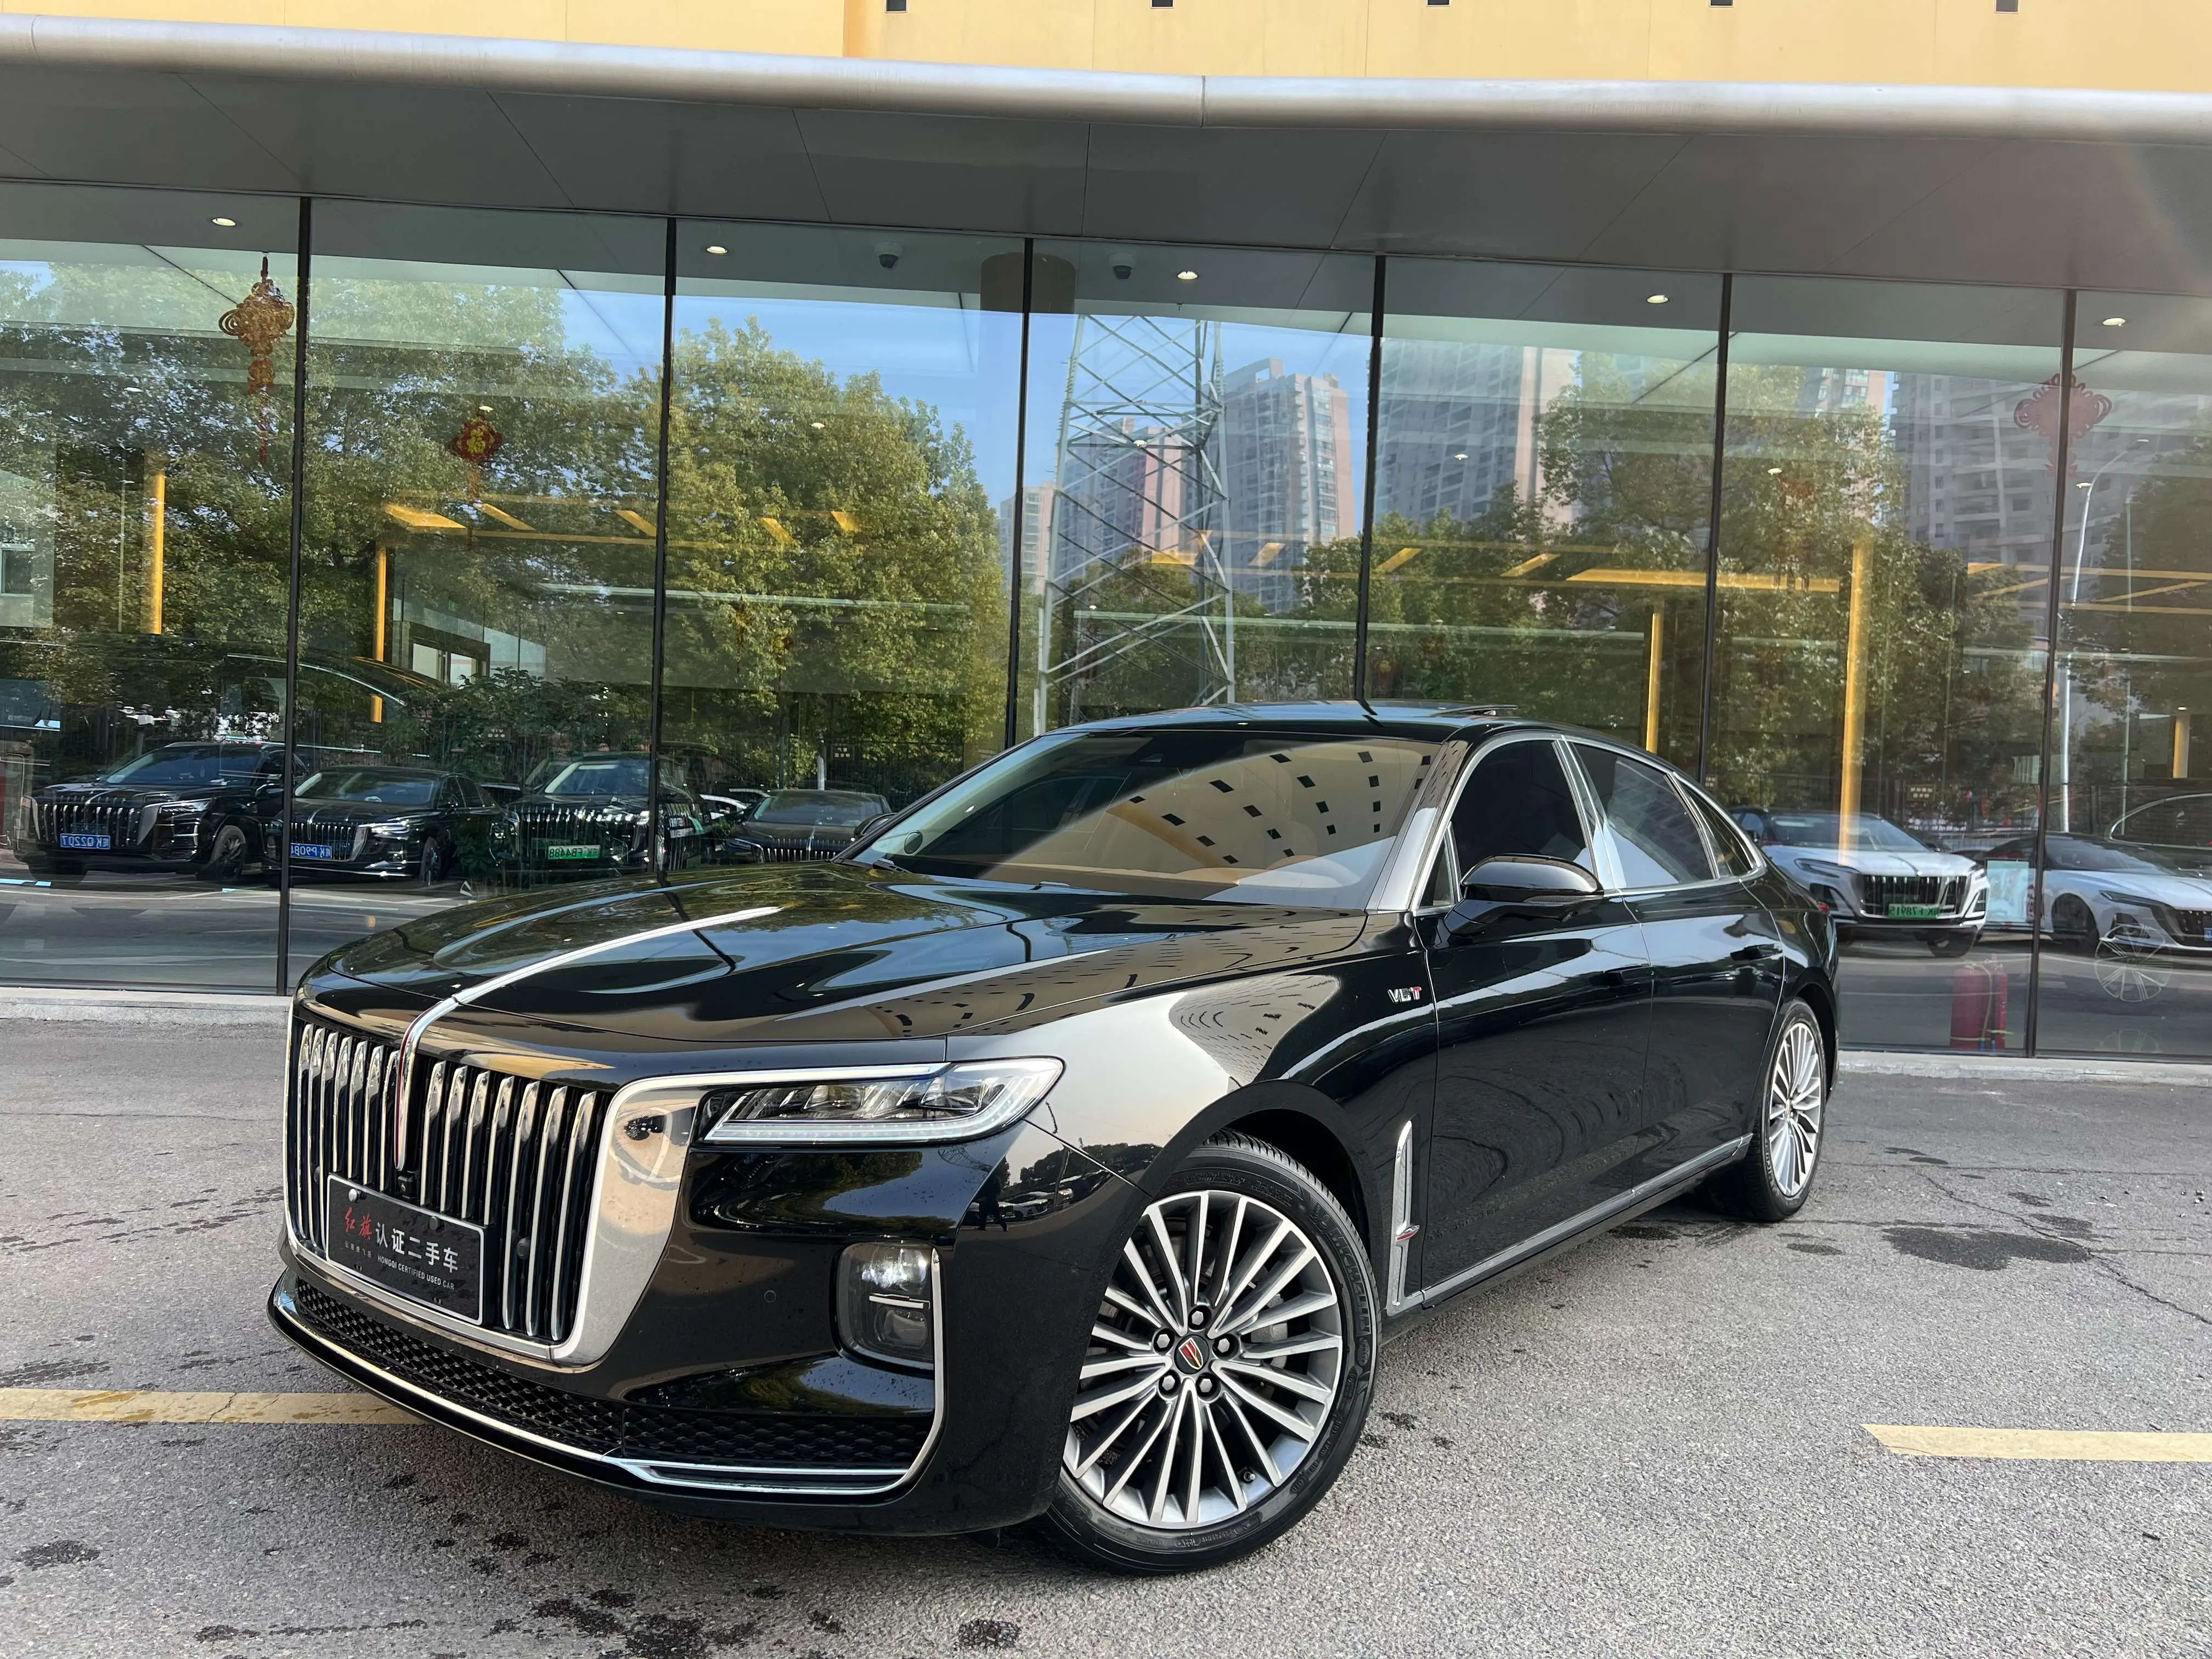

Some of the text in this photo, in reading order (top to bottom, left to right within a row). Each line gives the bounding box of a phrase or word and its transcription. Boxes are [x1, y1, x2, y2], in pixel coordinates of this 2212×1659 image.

[377, 1255, 455, 1290] HONGQI CERTIFIED USED CAR
